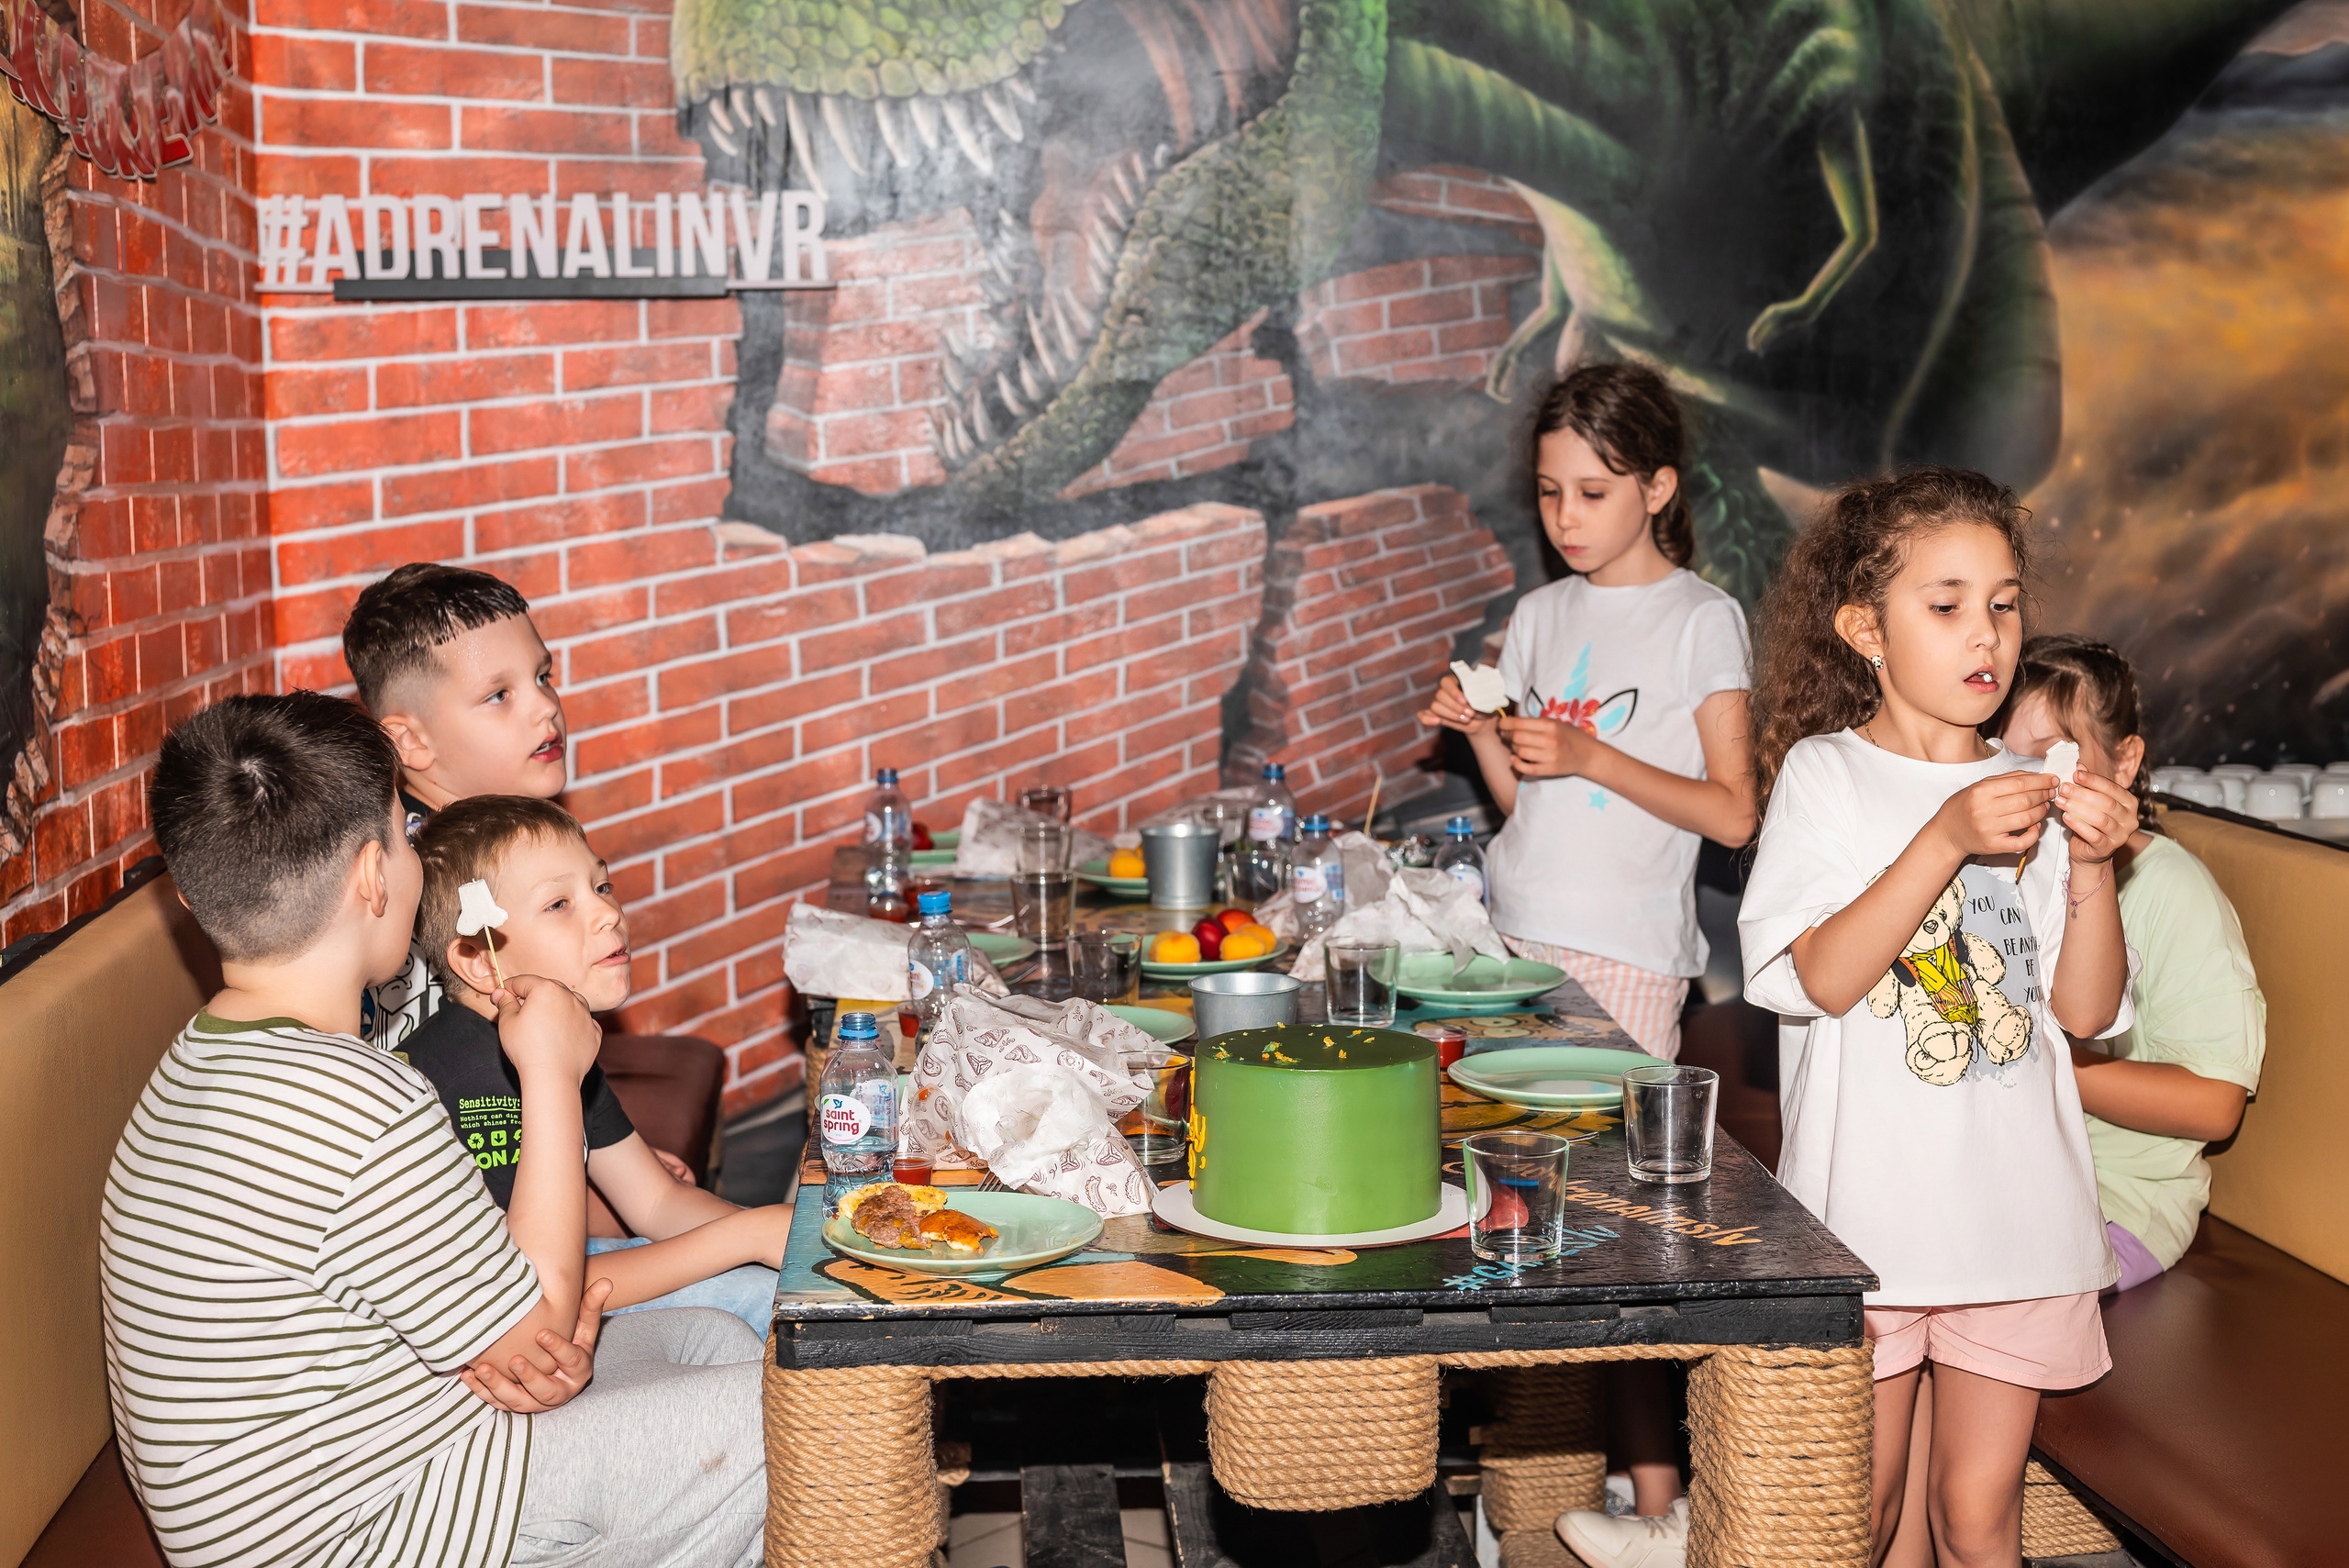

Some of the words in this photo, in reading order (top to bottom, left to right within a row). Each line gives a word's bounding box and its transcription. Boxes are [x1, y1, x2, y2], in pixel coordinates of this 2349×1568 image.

[260, 190, 829, 284] #ADRENALINVR
[1967, 895, 1996, 914] YOU
[2000, 907, 2022, 925] CAN
[2003, 938, 2019, 956] BE
[2025, 959, 2035, 977] BE
[459, 1095, 520, 1109] Sensitivity:
[460, 1114, 487, 1122] Nothing
[826, 1108, 855, 1121] saint
[823, 1118, 860, 1136] spring
[471, 1149, 507, 1170] ON
